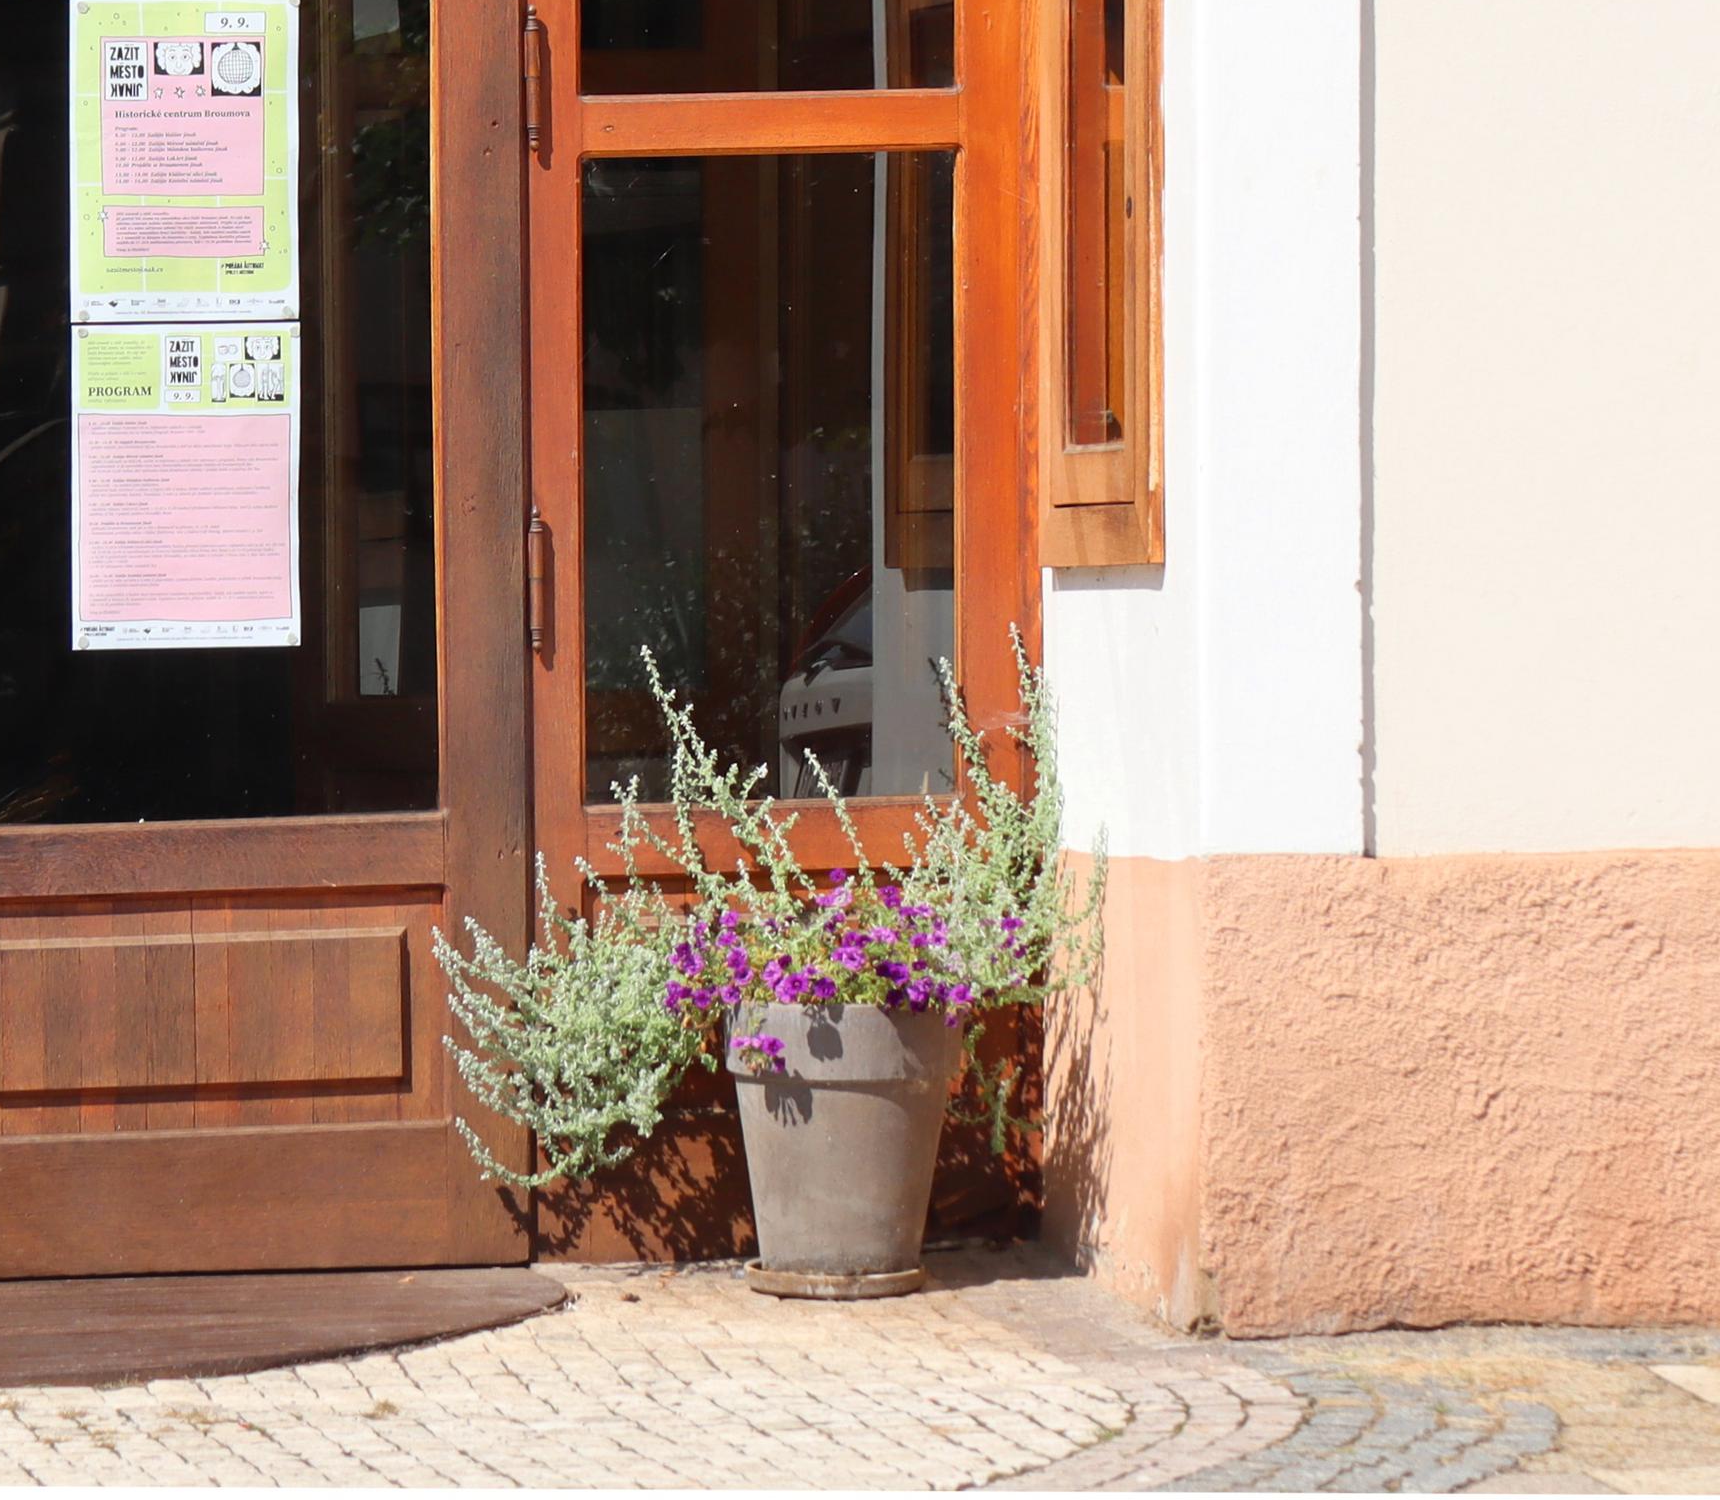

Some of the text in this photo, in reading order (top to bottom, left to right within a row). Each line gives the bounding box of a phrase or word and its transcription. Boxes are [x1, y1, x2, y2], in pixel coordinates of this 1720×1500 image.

[114, 110, 251, 119] Historické centrum Broumova
[87, 386, 152, 398] PROGRAM
